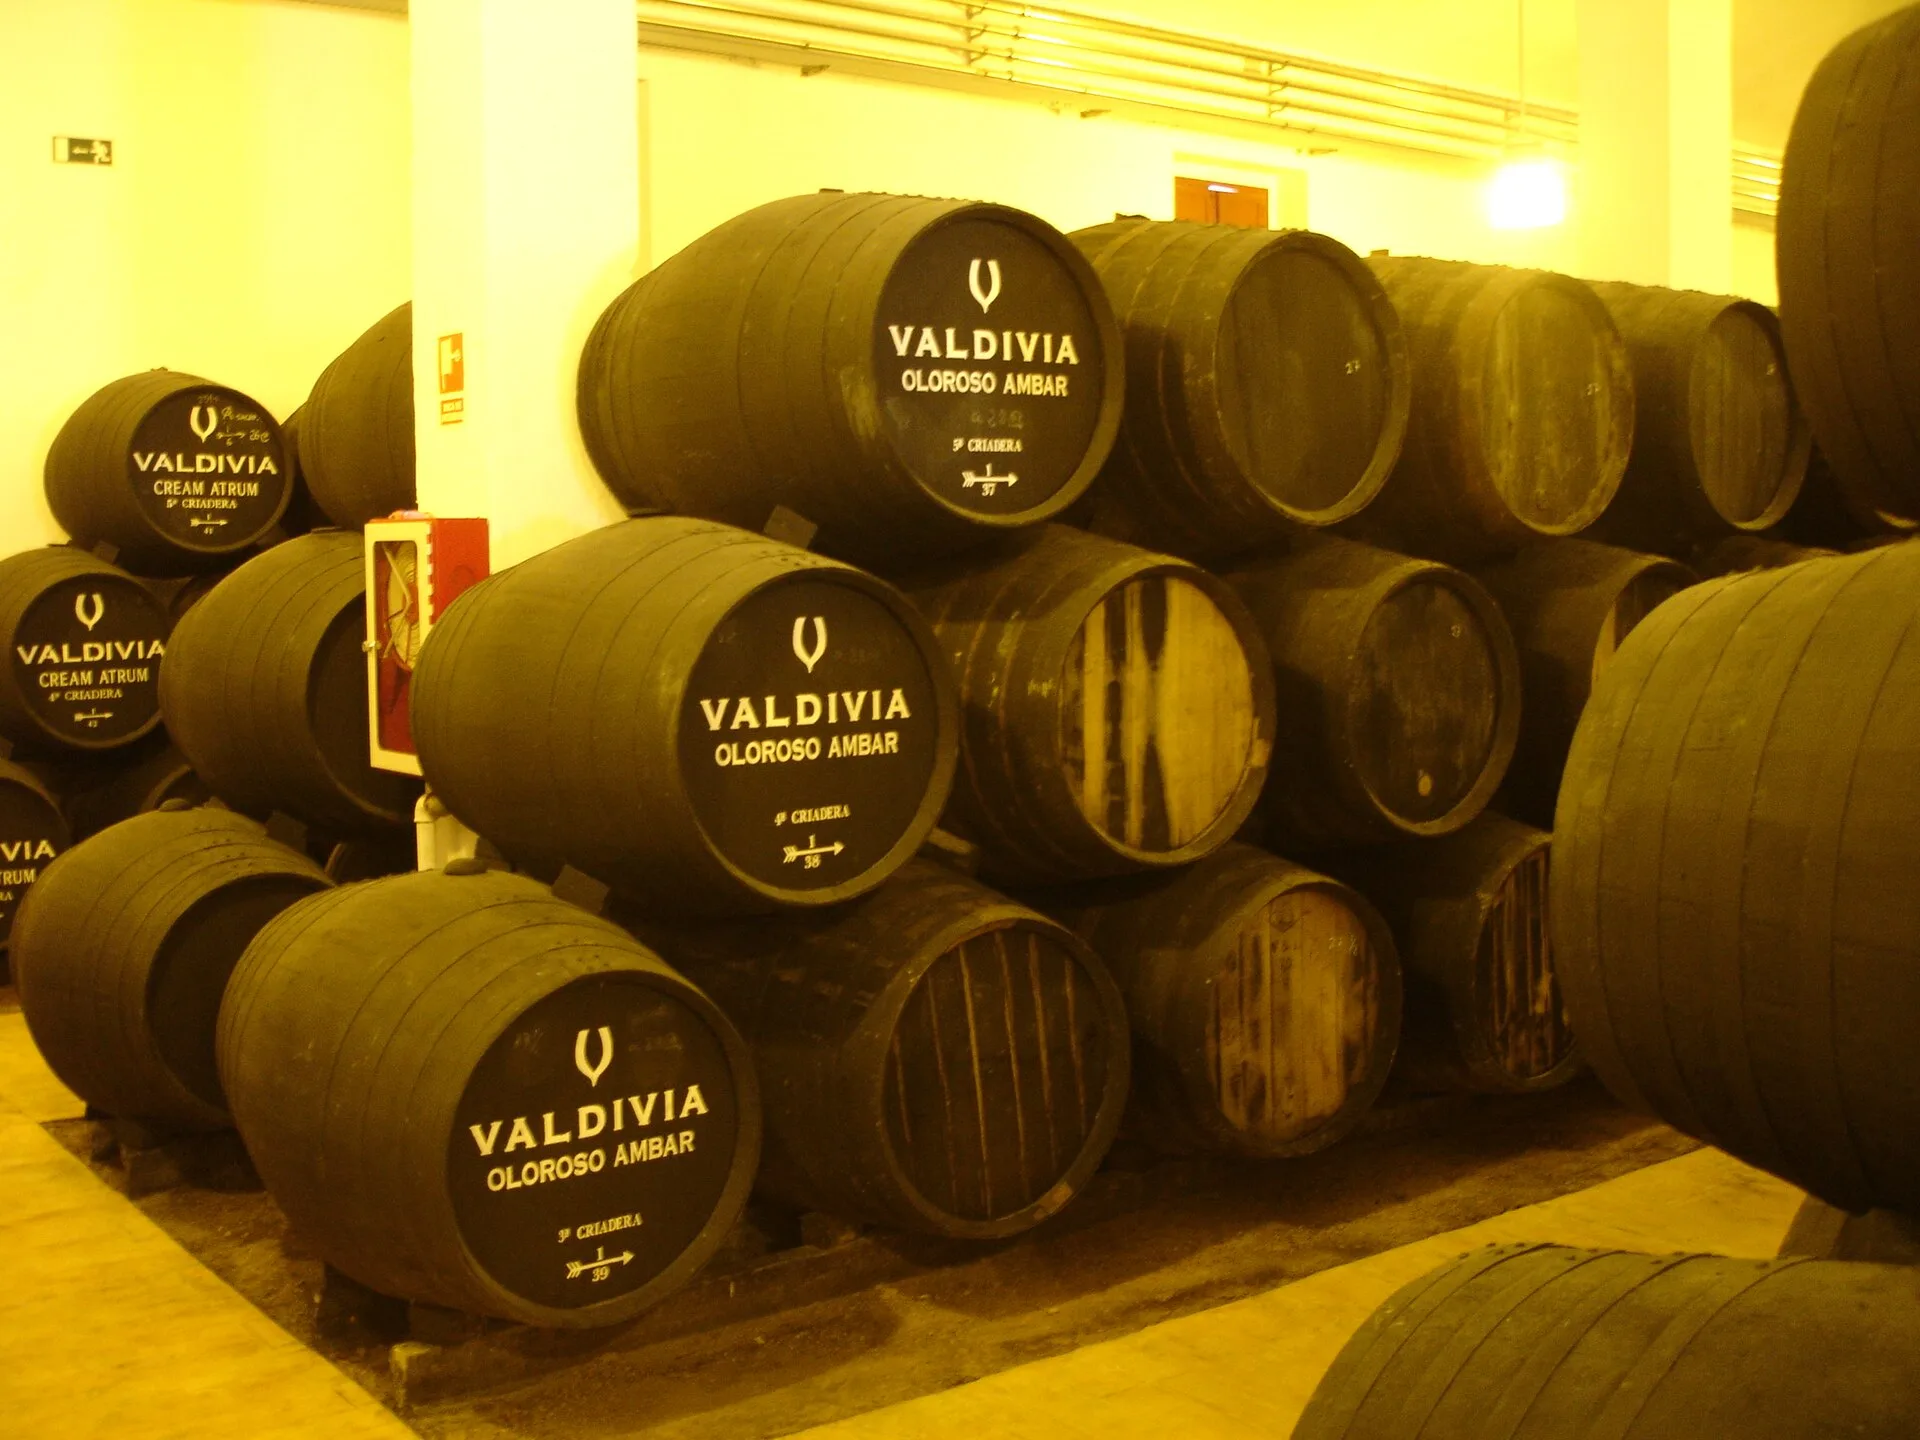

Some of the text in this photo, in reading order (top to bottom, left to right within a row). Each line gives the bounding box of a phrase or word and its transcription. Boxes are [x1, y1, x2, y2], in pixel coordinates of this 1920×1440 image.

[888, 325, 1080, 365] VALDIVIA
[901, 369, 1069, 397] OLOROSO AMBAR
[967, 438, 1023, 453] CRIADERA
[132, 452, 279, 475] VALDIVIA
[153, 481, 259, 497] CREAM ATRUM
[981, 483, 997, 496] 37
[181, 499, 238, 509] CRIADERA
[16, 639, 167, 665] VALDIVIA
[39, 667, 149, 688] CREAM ATRUM
[64, 688, 123, 701] CRIADERA
[700, 688, 911, 731] VALDIVIA
[715, 731, 899, 767] OLOROSO AMBAR
[791, 804, 851, 824] CRIADERA
[804, 854, 821, 869] 38
[469, 1084, 709, 1156] VALDIVIA
[487, 1130, 696, 1192] OLOROSO AMBAR
[576, 1212, 643, 1239] CRIADERA
[592, 1266, 610, 1282] 39
